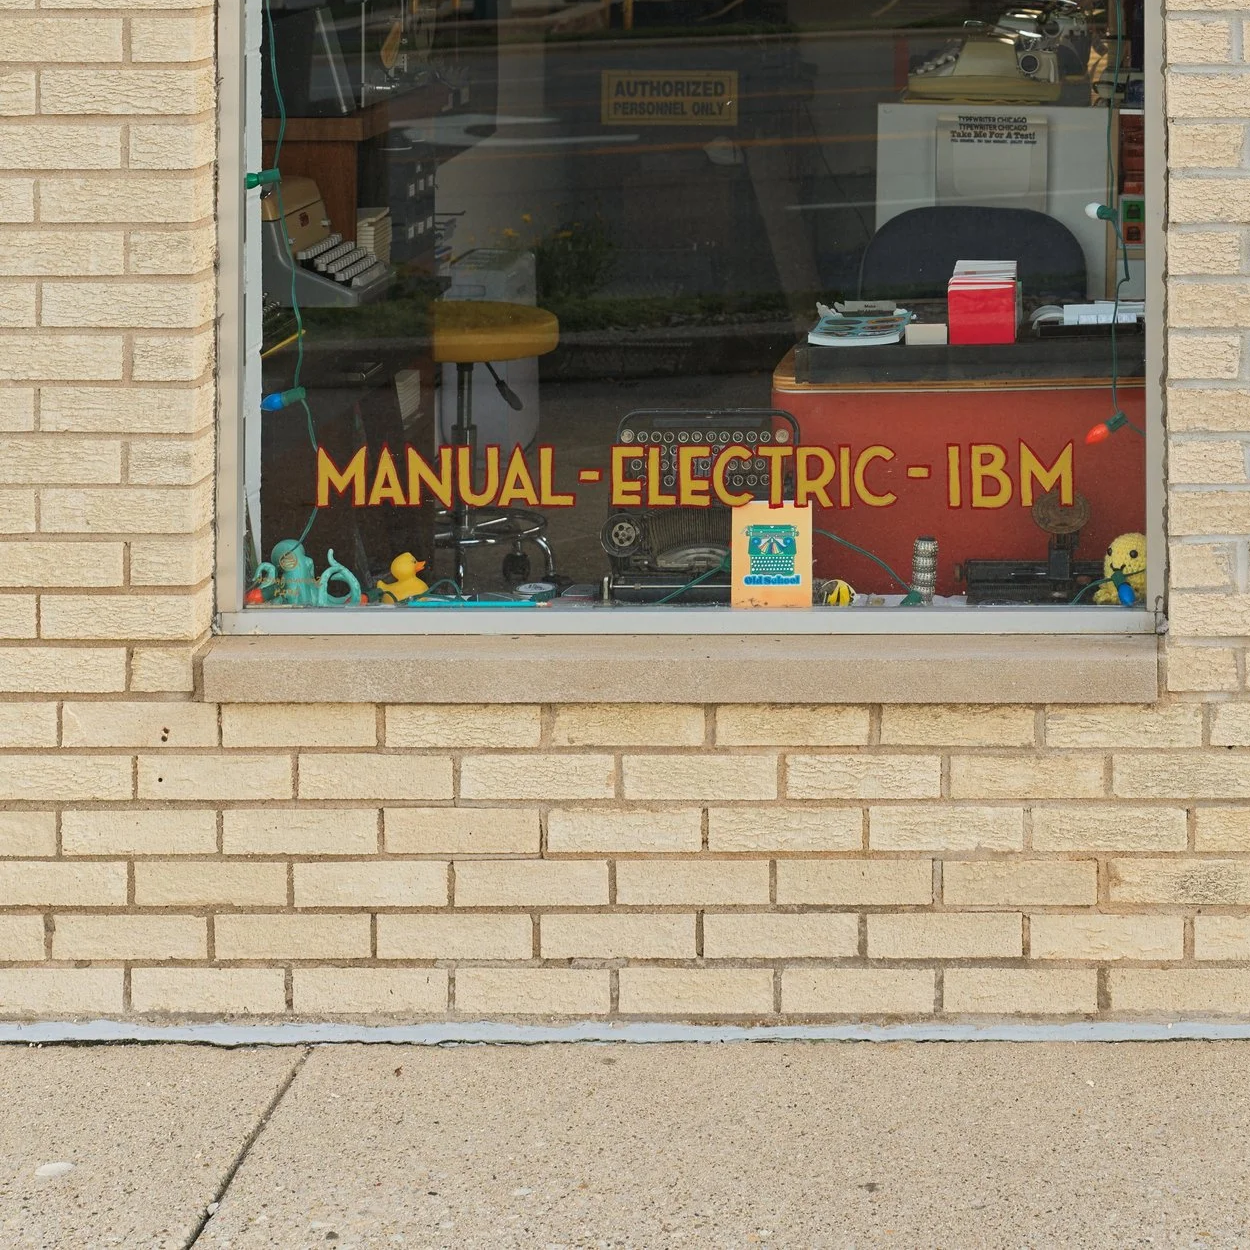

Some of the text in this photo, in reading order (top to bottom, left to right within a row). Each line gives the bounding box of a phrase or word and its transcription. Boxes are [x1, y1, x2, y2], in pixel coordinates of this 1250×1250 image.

[615, 81, 726, 97] AUTHORIZED
[613, 102, 724, 115] PERSONNEL ONLY
[1013, 132, 1036, 140] Test!
[315, 441, 576, 510] MANUAL
[609, 443, 898, 511] ELECTRIC
[946, 438, 1074, 510] IBM
[744, 575, 800, 585] Old School
